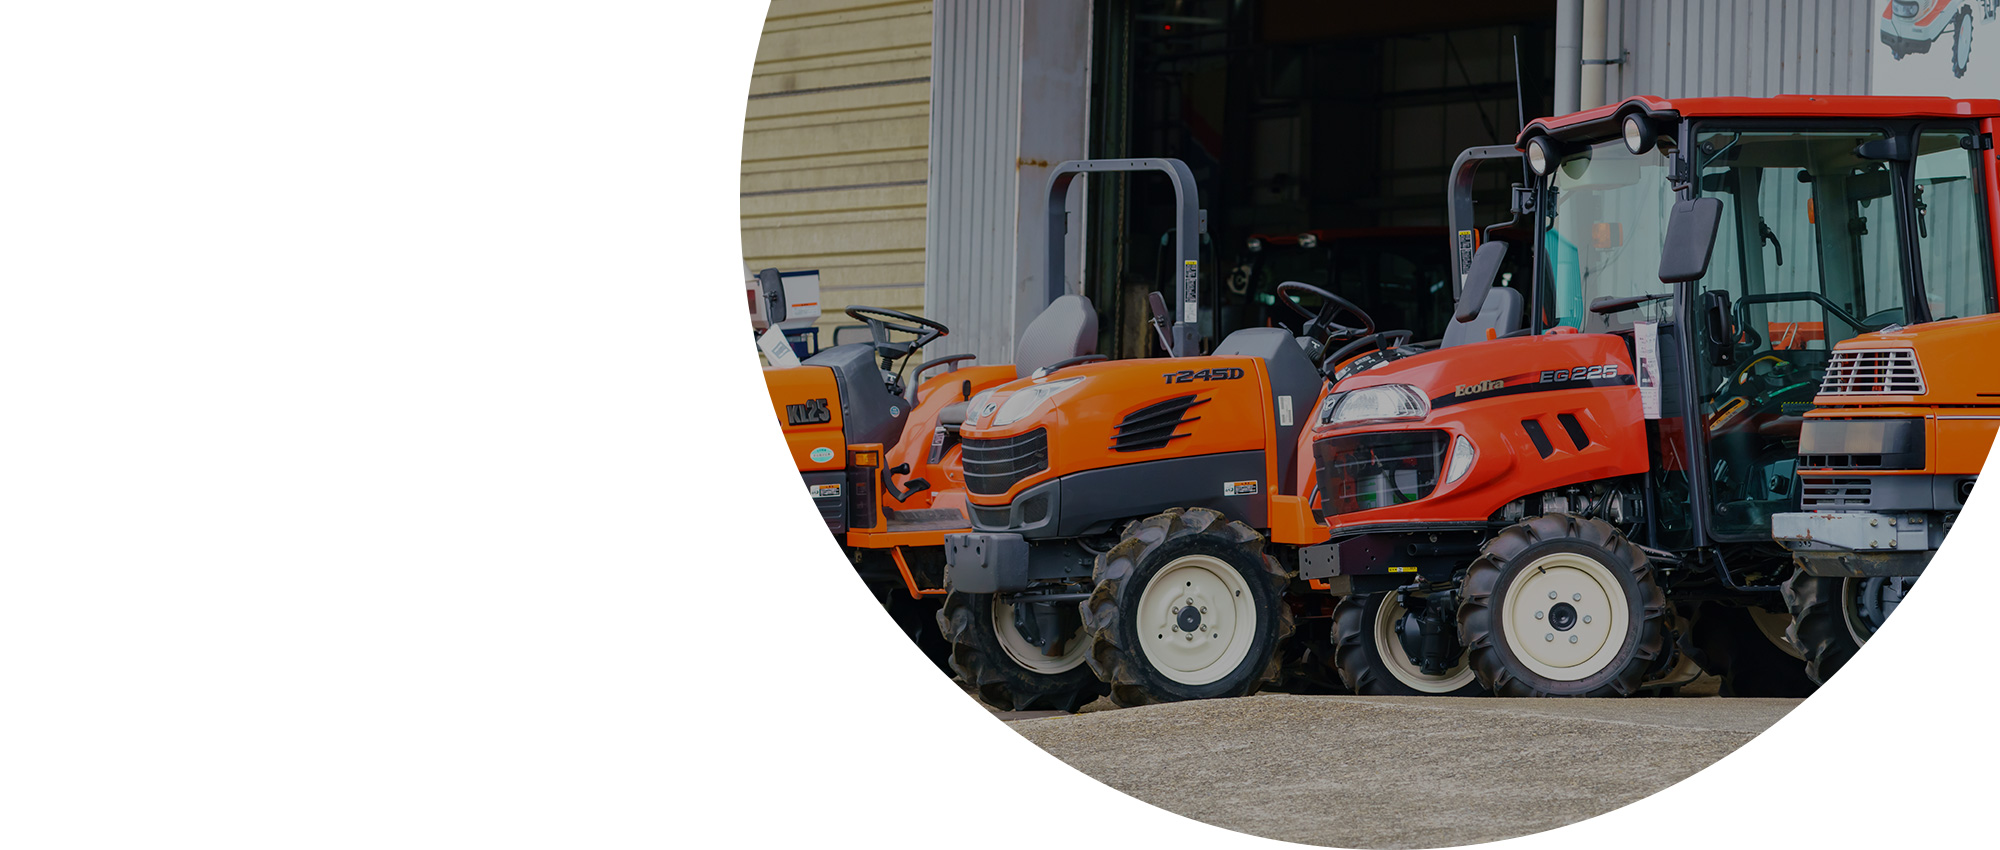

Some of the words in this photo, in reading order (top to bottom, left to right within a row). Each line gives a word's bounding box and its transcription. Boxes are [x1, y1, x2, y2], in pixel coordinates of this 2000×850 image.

[1162, 367, 1245, 384] T245D
[1454, 379, 1505, 398] EcoTra
[786, 398, 831, 426] KL25
